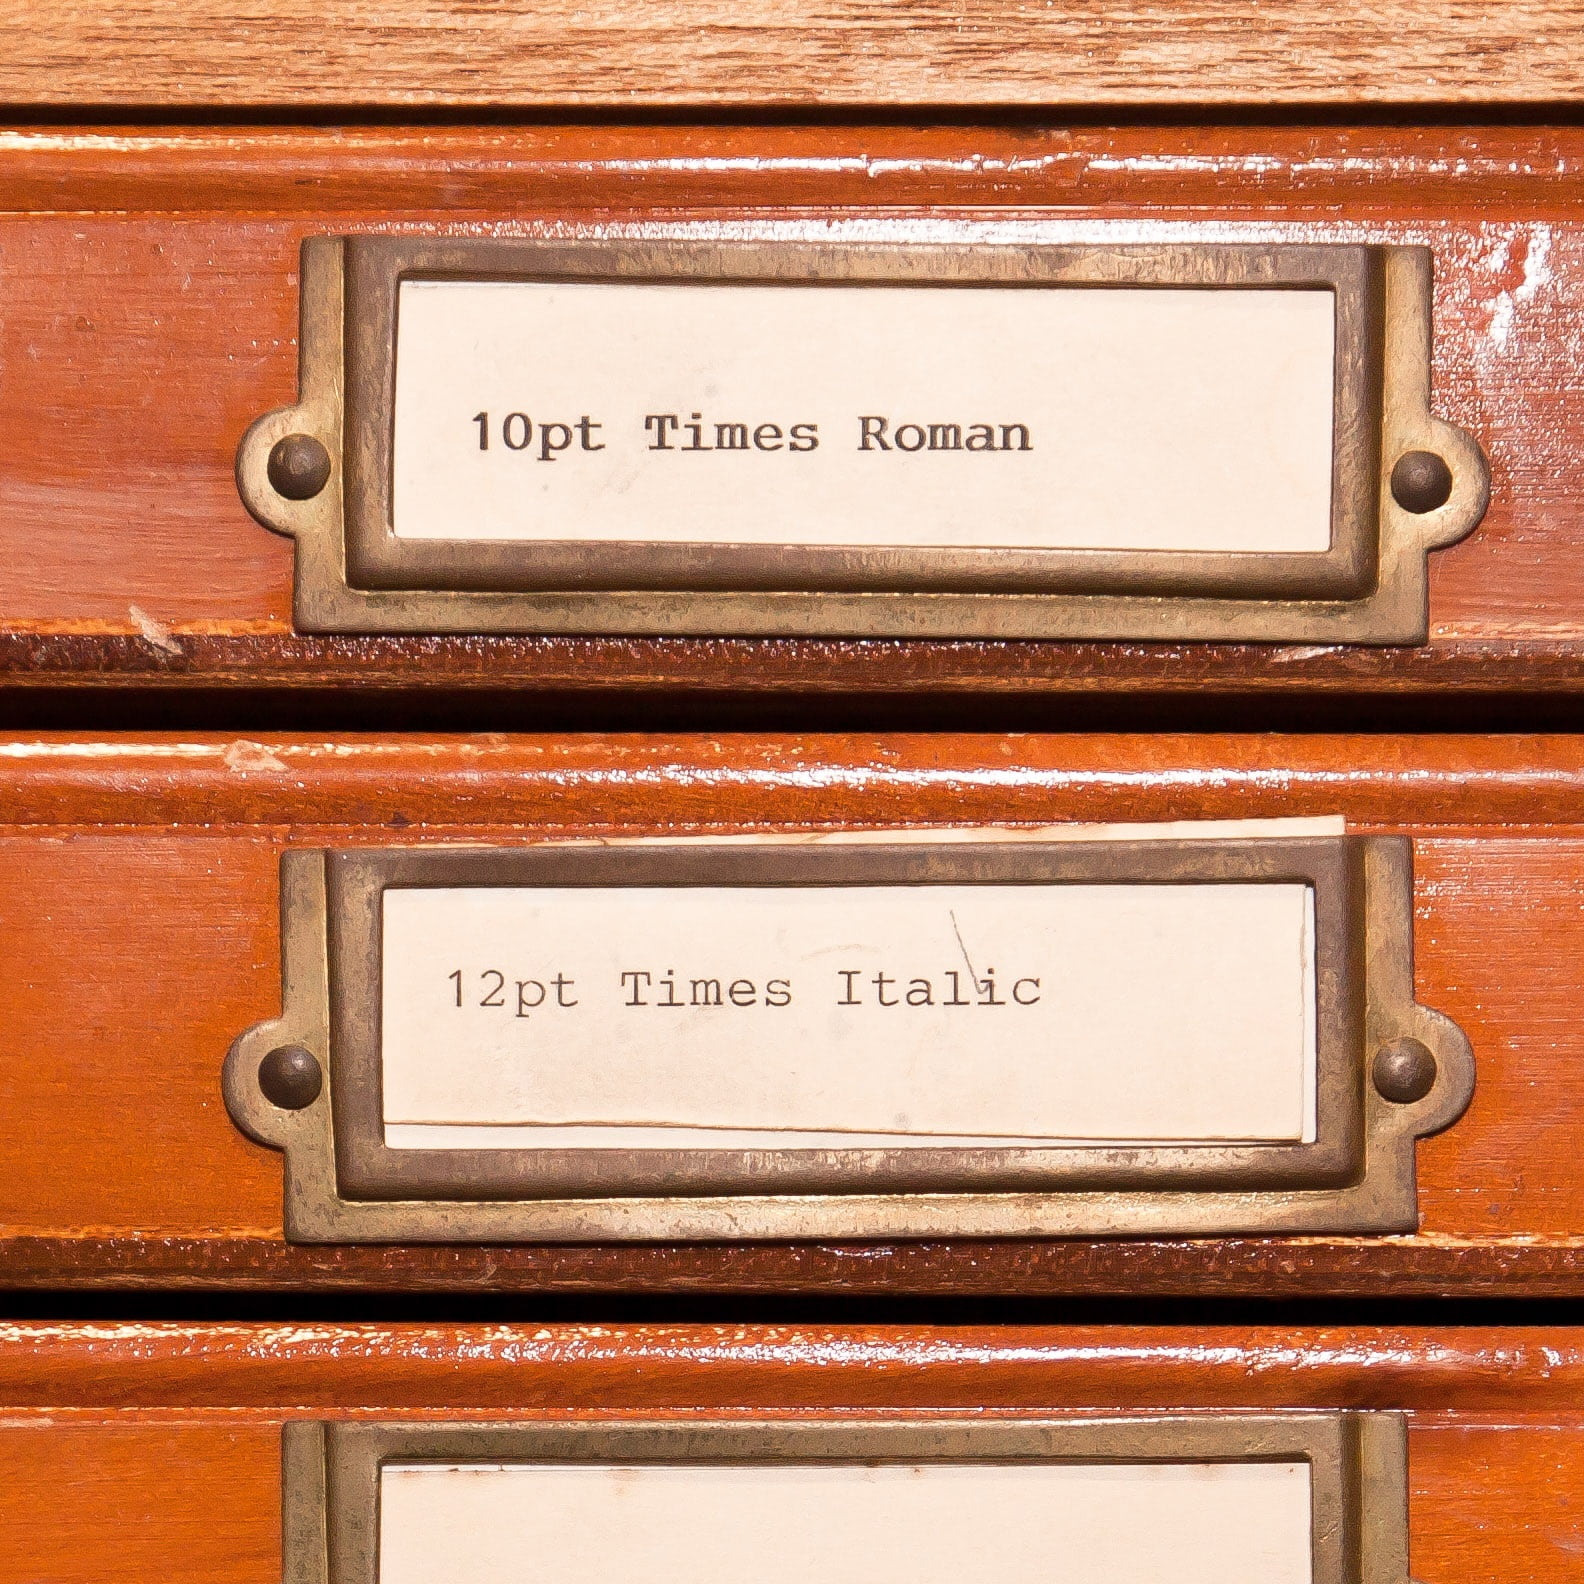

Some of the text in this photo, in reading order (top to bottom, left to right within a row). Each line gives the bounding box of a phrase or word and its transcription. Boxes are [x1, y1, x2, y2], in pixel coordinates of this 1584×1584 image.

[471, 411, 1034, 462] 10pt Times Roman
[447, 966, 1041, 1019] 12pt Times Italic
